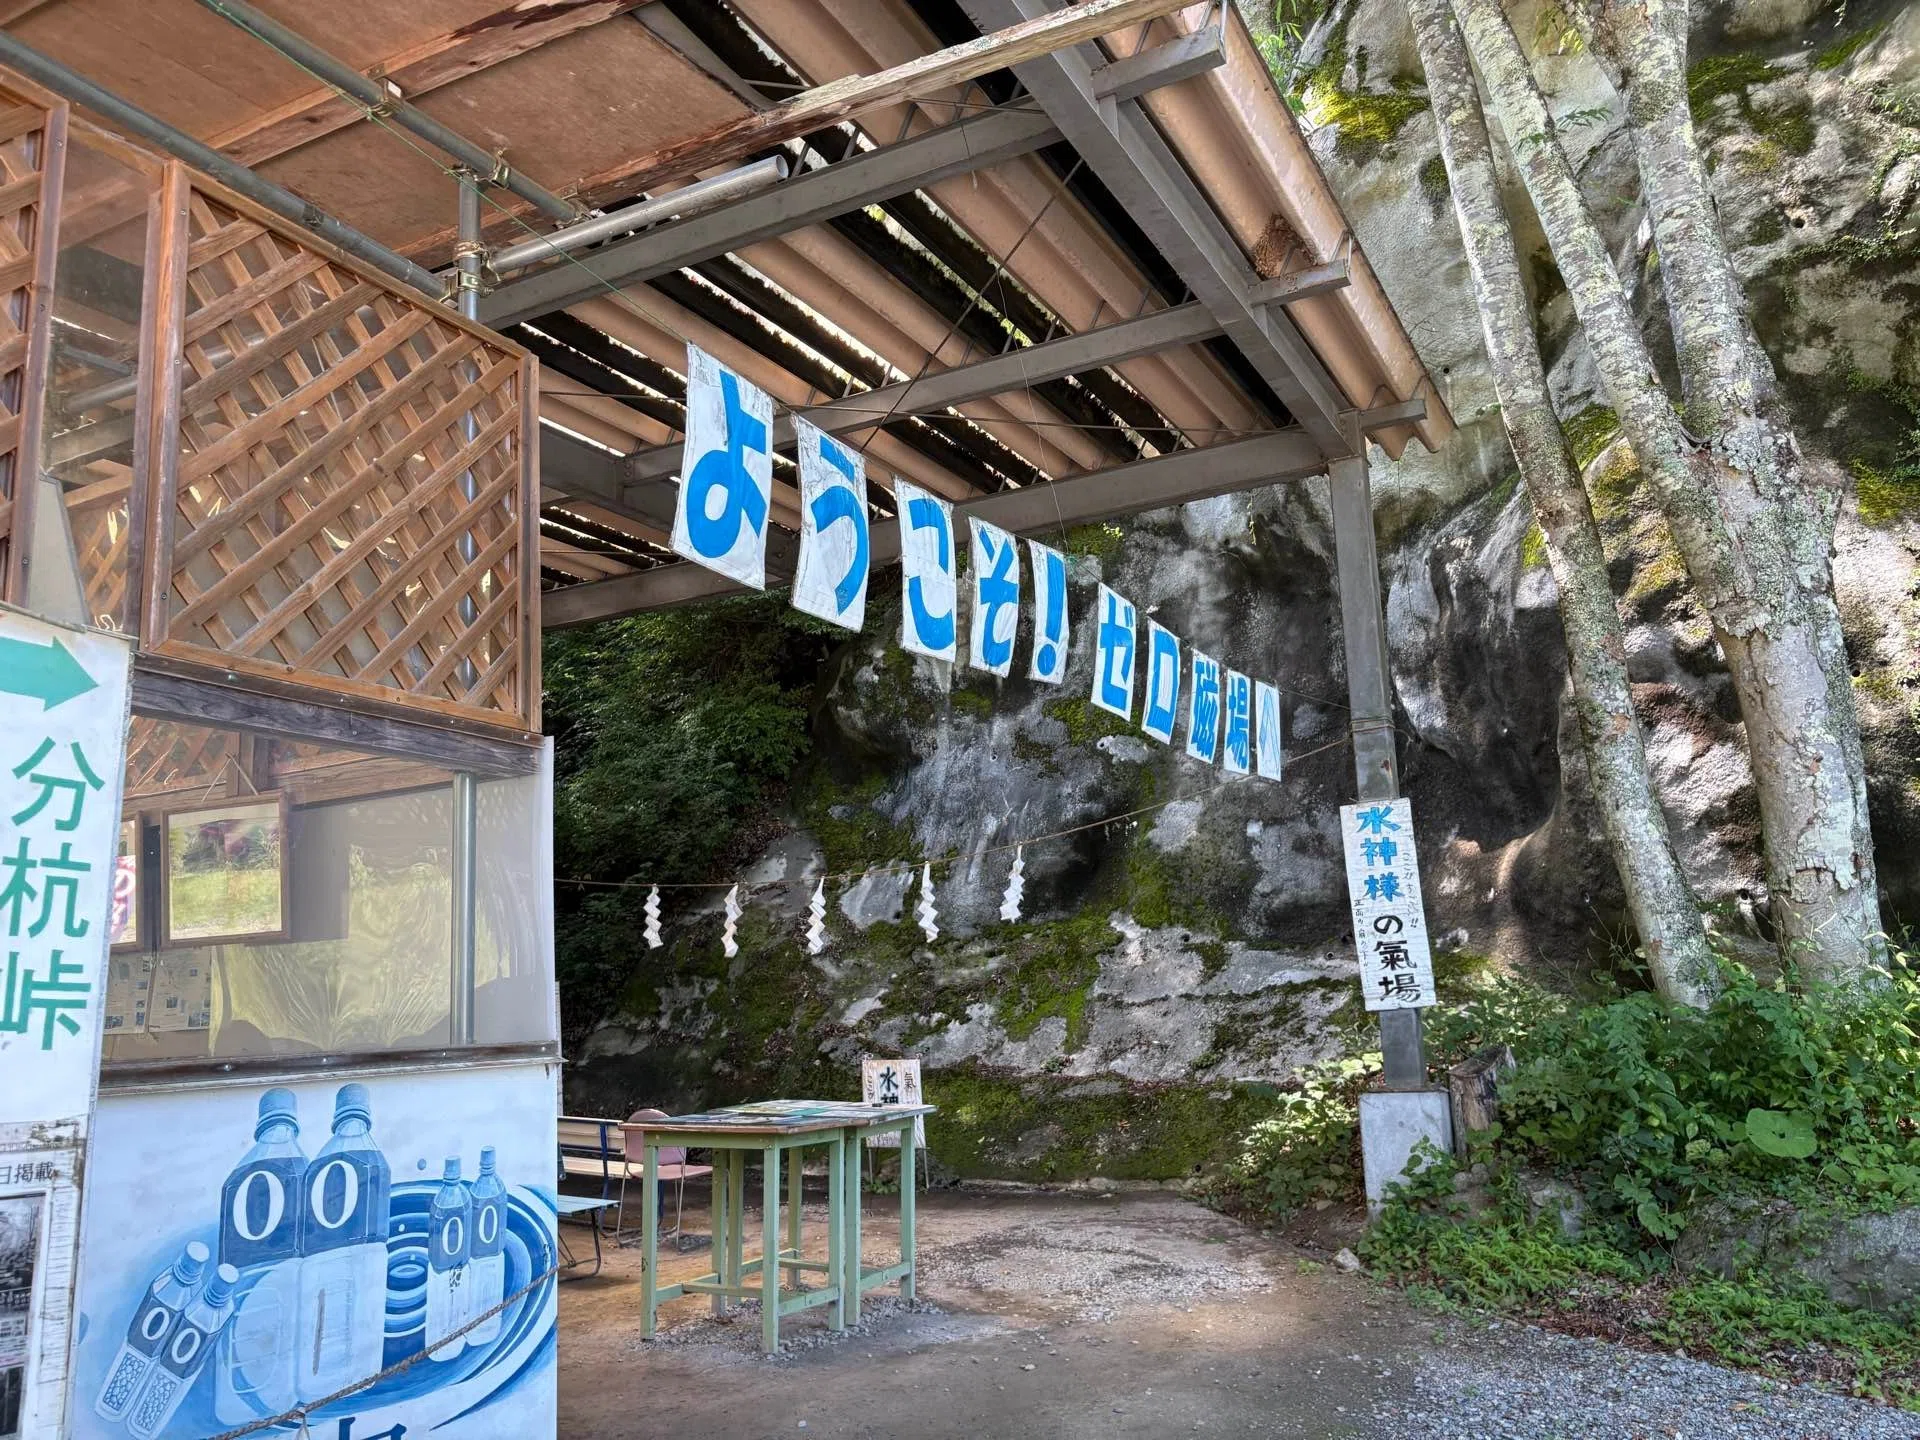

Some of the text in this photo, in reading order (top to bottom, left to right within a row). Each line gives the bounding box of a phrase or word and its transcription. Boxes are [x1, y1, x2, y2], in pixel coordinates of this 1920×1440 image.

[0, 736, 105, 1050] 分杭峠
[1357, 806, 1421, 1001] 水神様の氣場
